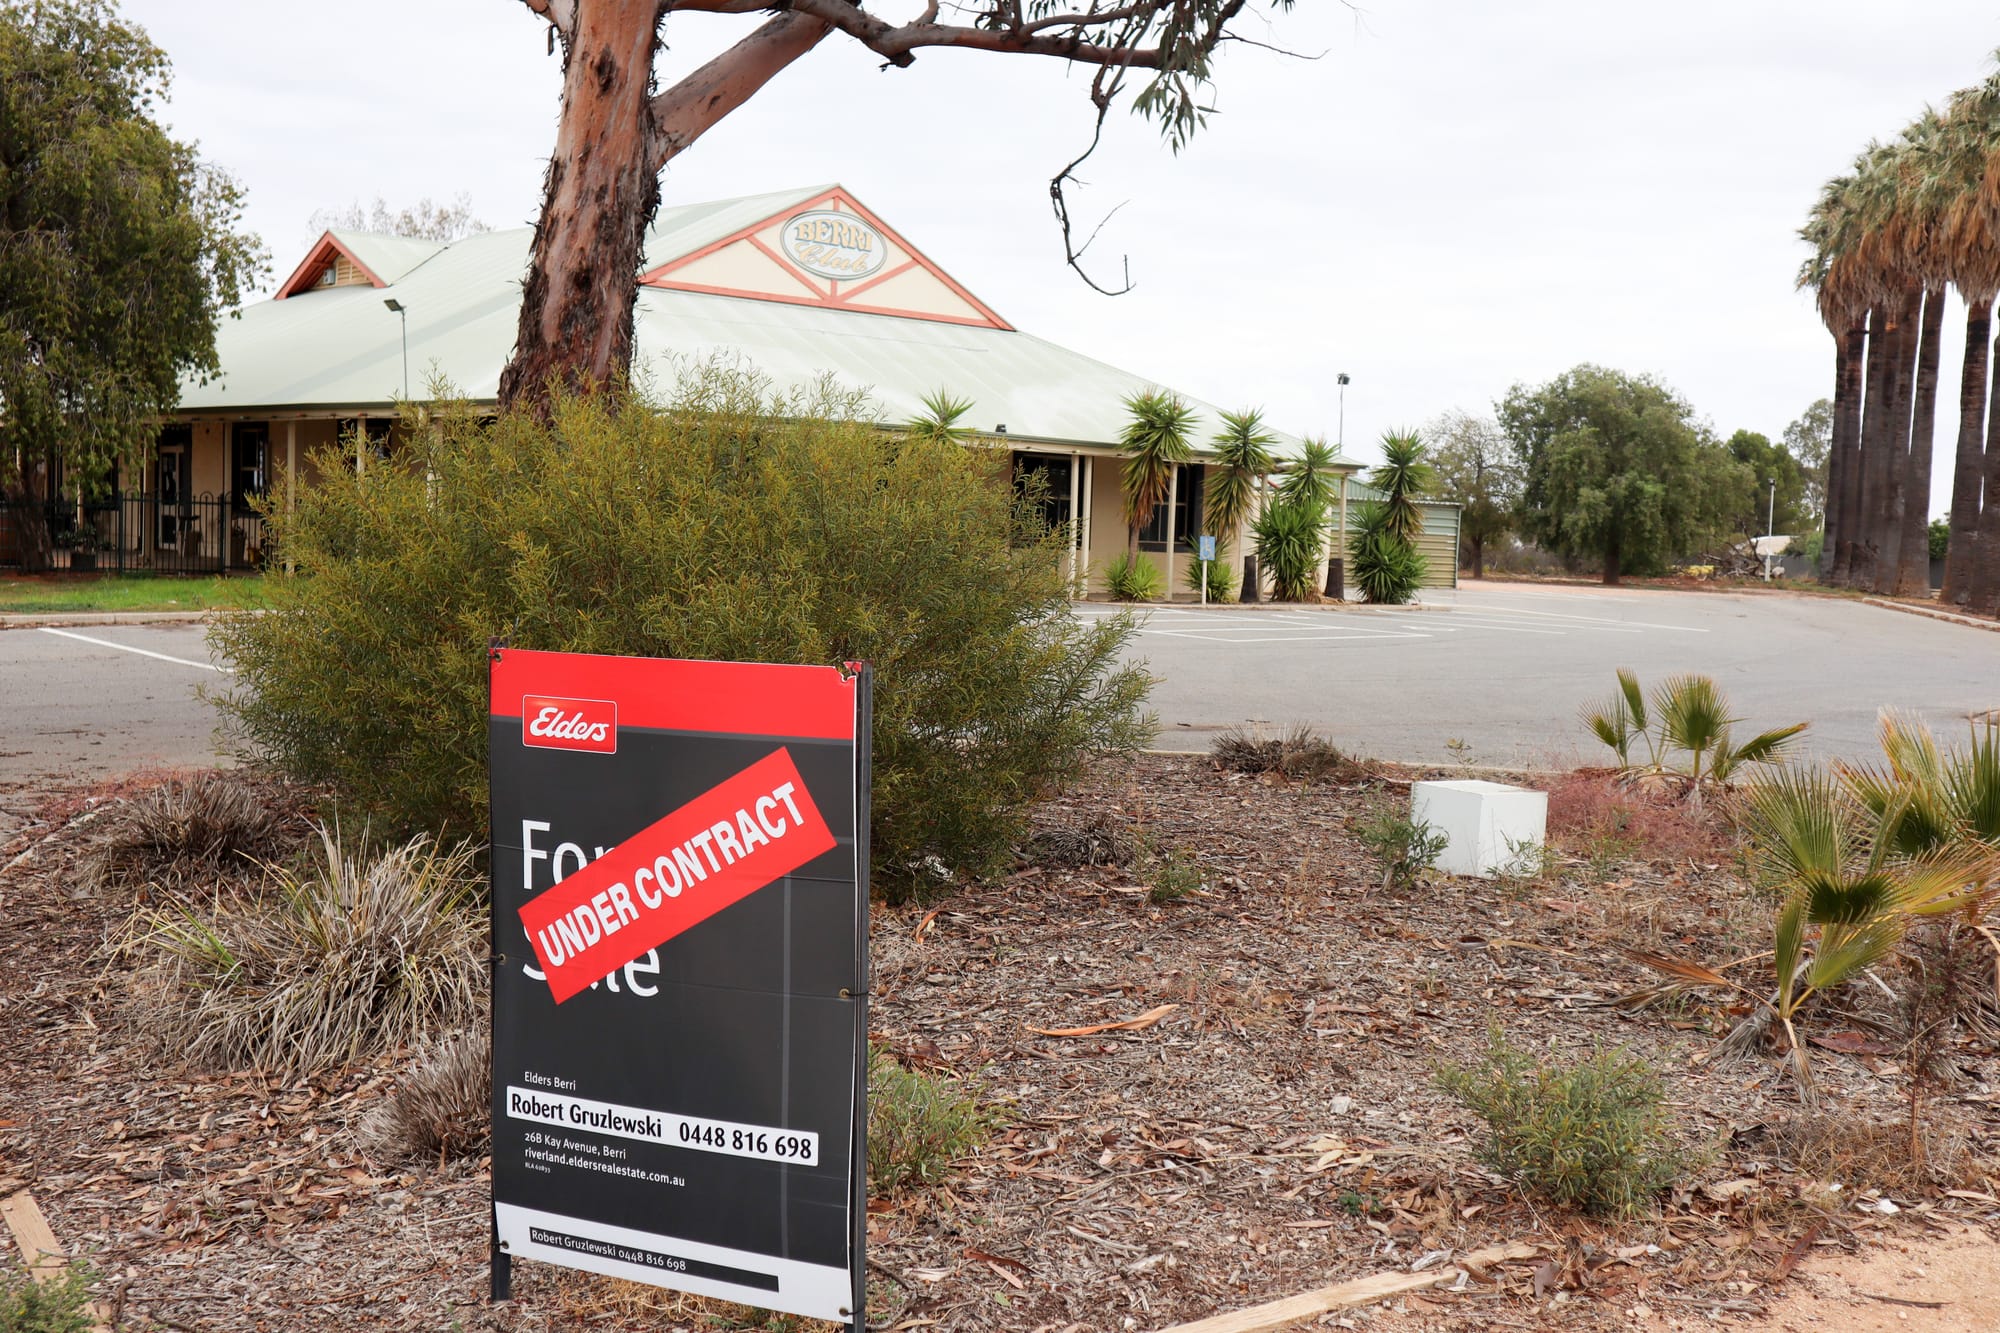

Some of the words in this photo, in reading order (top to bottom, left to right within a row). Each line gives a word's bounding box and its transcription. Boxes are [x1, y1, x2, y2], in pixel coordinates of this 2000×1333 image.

[794, 219, 874, 252] BERRI
[793, 241, 870, 273] Club
[529, 706, 610, 742] Elders
[522, 819, 616, 890] Fo
[537, 881, 640, 967] UNDER
[634, 781, 805, 910] CONTRACT
[524, 1071, 552, 1087] Elders
[554, 1076, 576, 1091] Berri
[511, 1093, 564, 1121] Robert
[569, 1104, 662, 1138] Gruzlewski
[679, 1122, 725, 1148] 0448
[732, 1129, 768, 1154] 816
[775, 1135, 812, 1159] 698
[524, 1132, 543, 1144] 26B
[544, 1134, 561, 1150] Kay
[562, 1138, 601, 1157] Avenue,
[603, 1145, 626, 1160] Berri
[524, 1147, 685, 1187] riverland.eldersrealestate.com.au
[531, 1229, 562, 1246] Robert
[564, 1236, 616, 1257] Gruzlewski
[618, 1249, 644, 1263] 0448
[646, 1253, 664, 1266] 816
[666, 1257, 687, 1272] 698
